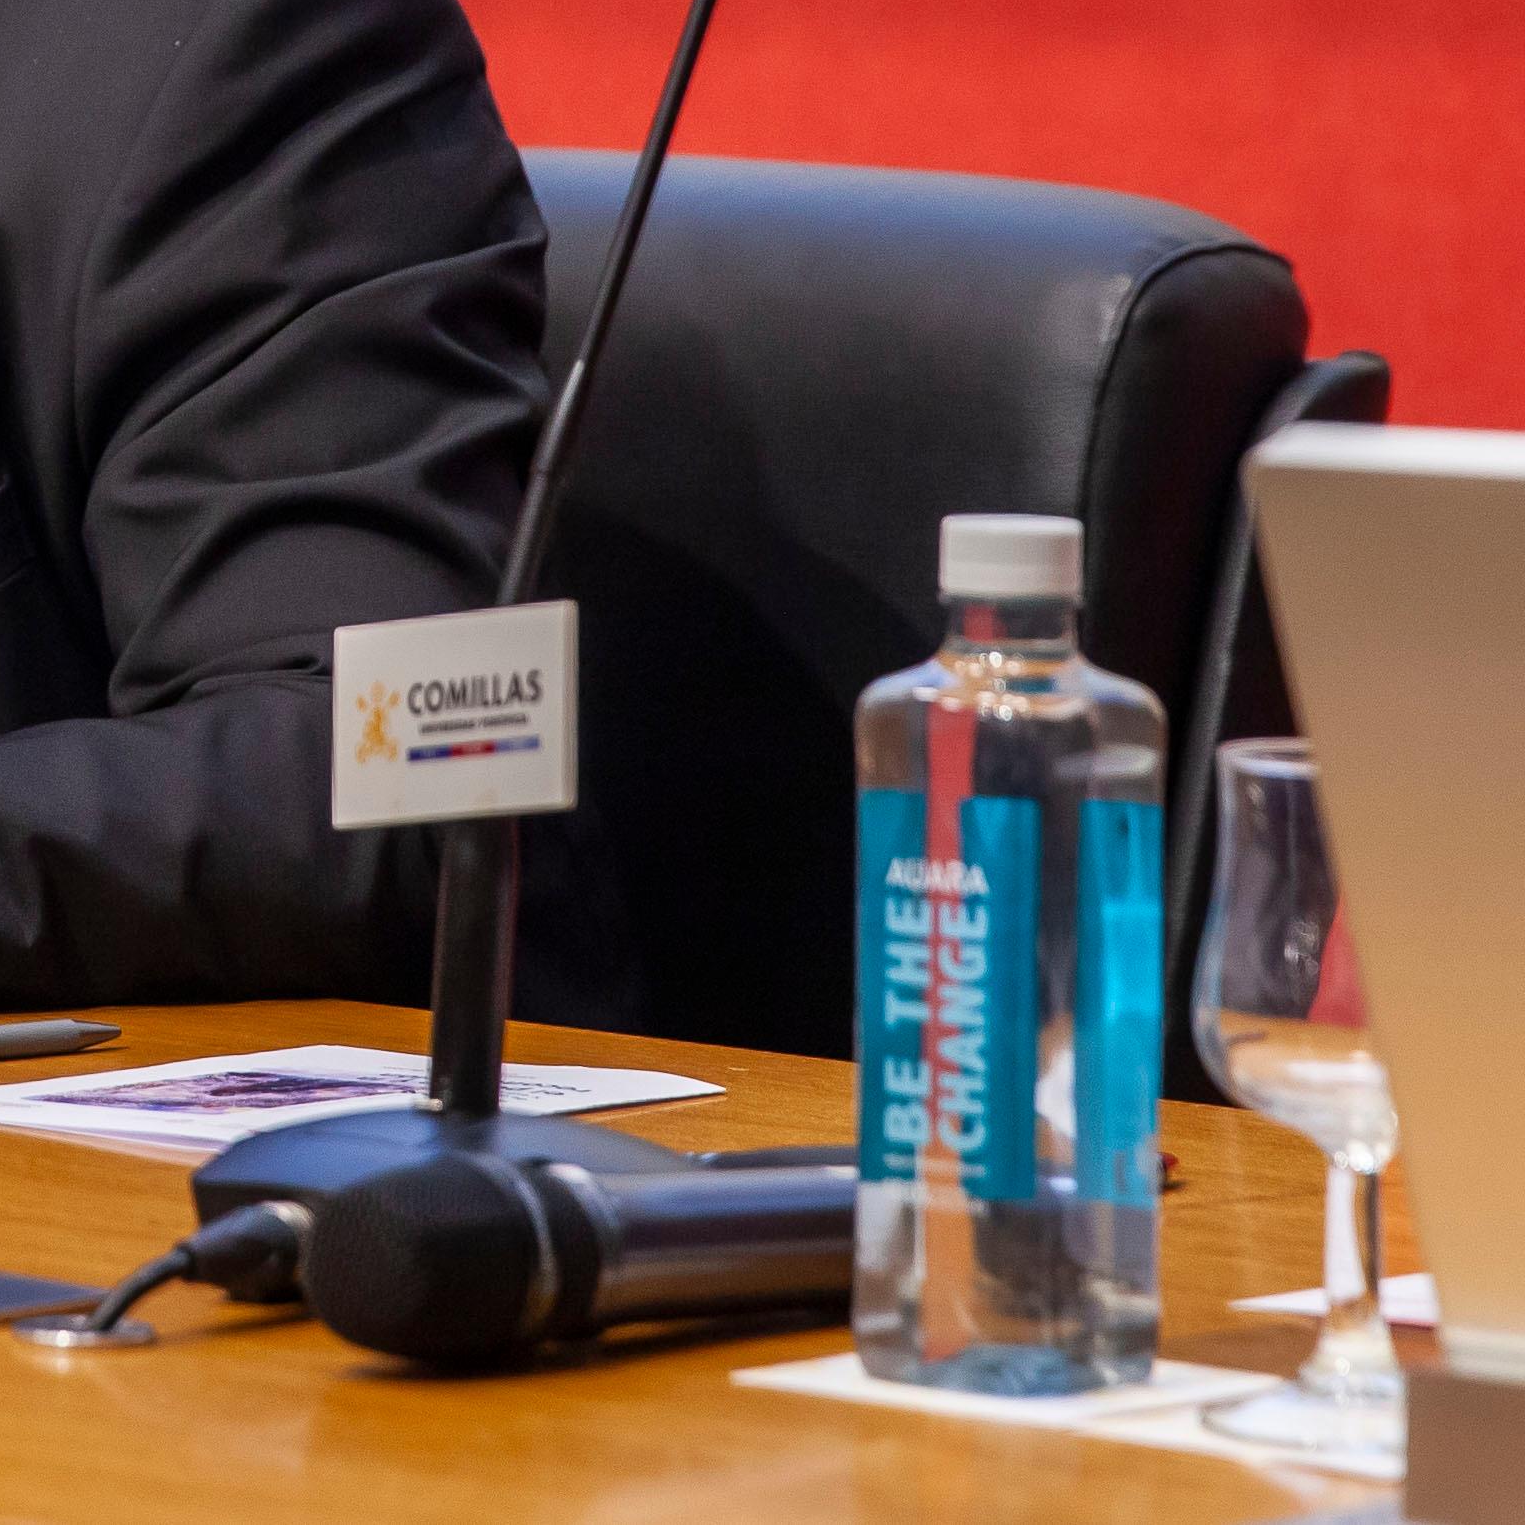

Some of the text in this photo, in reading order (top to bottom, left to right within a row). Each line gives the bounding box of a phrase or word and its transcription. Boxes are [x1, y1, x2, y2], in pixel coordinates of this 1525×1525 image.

[407, 668, 543, 715] COMILLAS
[883, 898, 932, 1148] BE THE
[937, 902, 988, 1152] CHANGE
